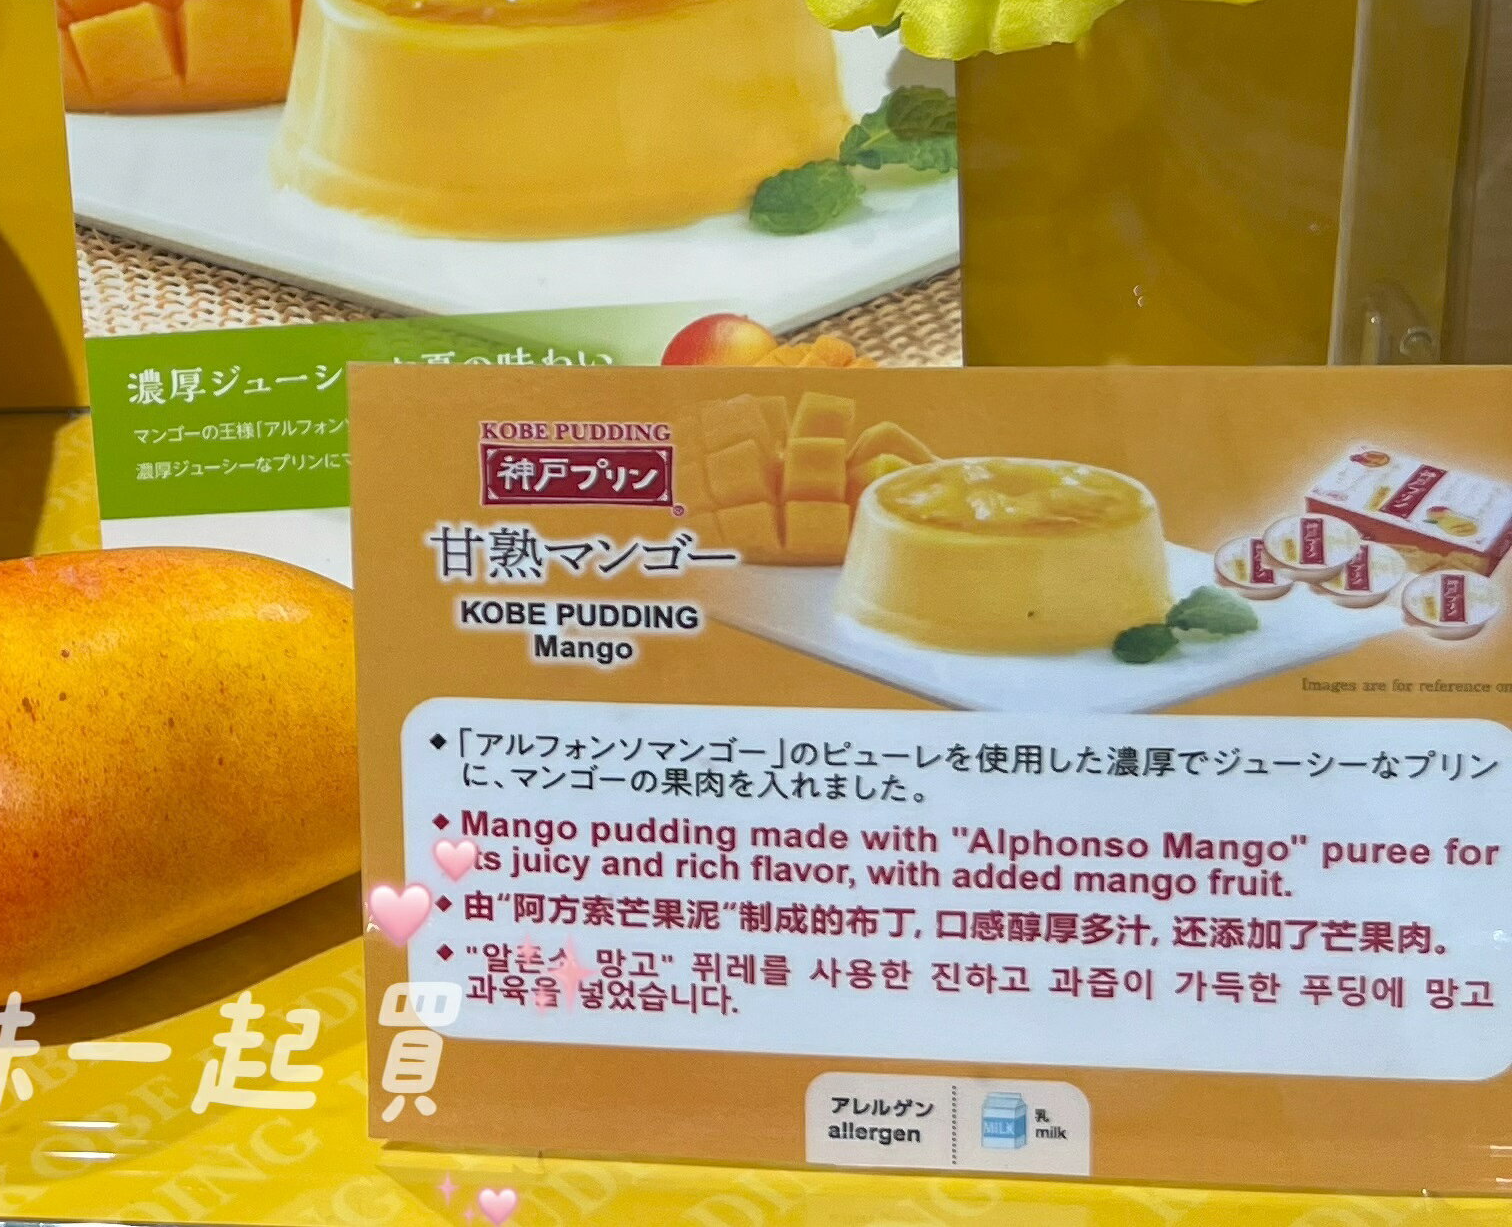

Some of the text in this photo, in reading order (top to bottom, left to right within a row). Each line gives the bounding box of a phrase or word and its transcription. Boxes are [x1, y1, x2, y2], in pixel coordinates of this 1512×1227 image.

[133, 417, 351, 445] マンゴーの王様「アルフォン
[481, 422, 671, 442] KOBE PUDDING
[496, 455, 659, 494] 神戸プリン
[430, 525, 737, 579] 甘熟マンゴー
[460, 600, 699, 630] KOBE PUDDING
[533, 634, 634, 665] Mango
[1301, 677, 1357, 694] Images
[1362, 681, 1386, 693] are
[1391, 678, 1413, 693] for
[1419, 678, 1491, 693] reference
[462, 763, 927, 805] に、マンゴーの果肉を入れました。
[461, 809, 1500, 869] Mango pudding made with "Alphonso Mango" puree for
[509, 845, 591, 882] juicy
[601, 850, 663, 878] and
[675, 851, 739, 881] rich
[750, 852, 858, 891] flavor,
[866, 858, 954, 888] with
[951, 862, 1062, 892] added
[1074, 870, 1198, 901] mango
[1207, 867, 1293, 898] fruit.
[466, 973, 739, 1015] 과육을 넣었습니다.
[595, 947, 674, 979] 망고"
[691, 952, 792, 987] 퓌레를
[809, 957, 913, 991] 사용한
[931, 961, 1031, 994] 진하고
[1048, 965, 1154, 1001] 과즙이
[1174, 970, 1281, 1004] 가득한
[1300, 974, 1405, 1009] 푸딩에
[1425, 977, 1495, 1010] 망고
[830, 1096, 935, 1118] アレルゲン
[827, 1121, 921, 1146] allergen
[1035, 1126, 1067, 1141] milk
